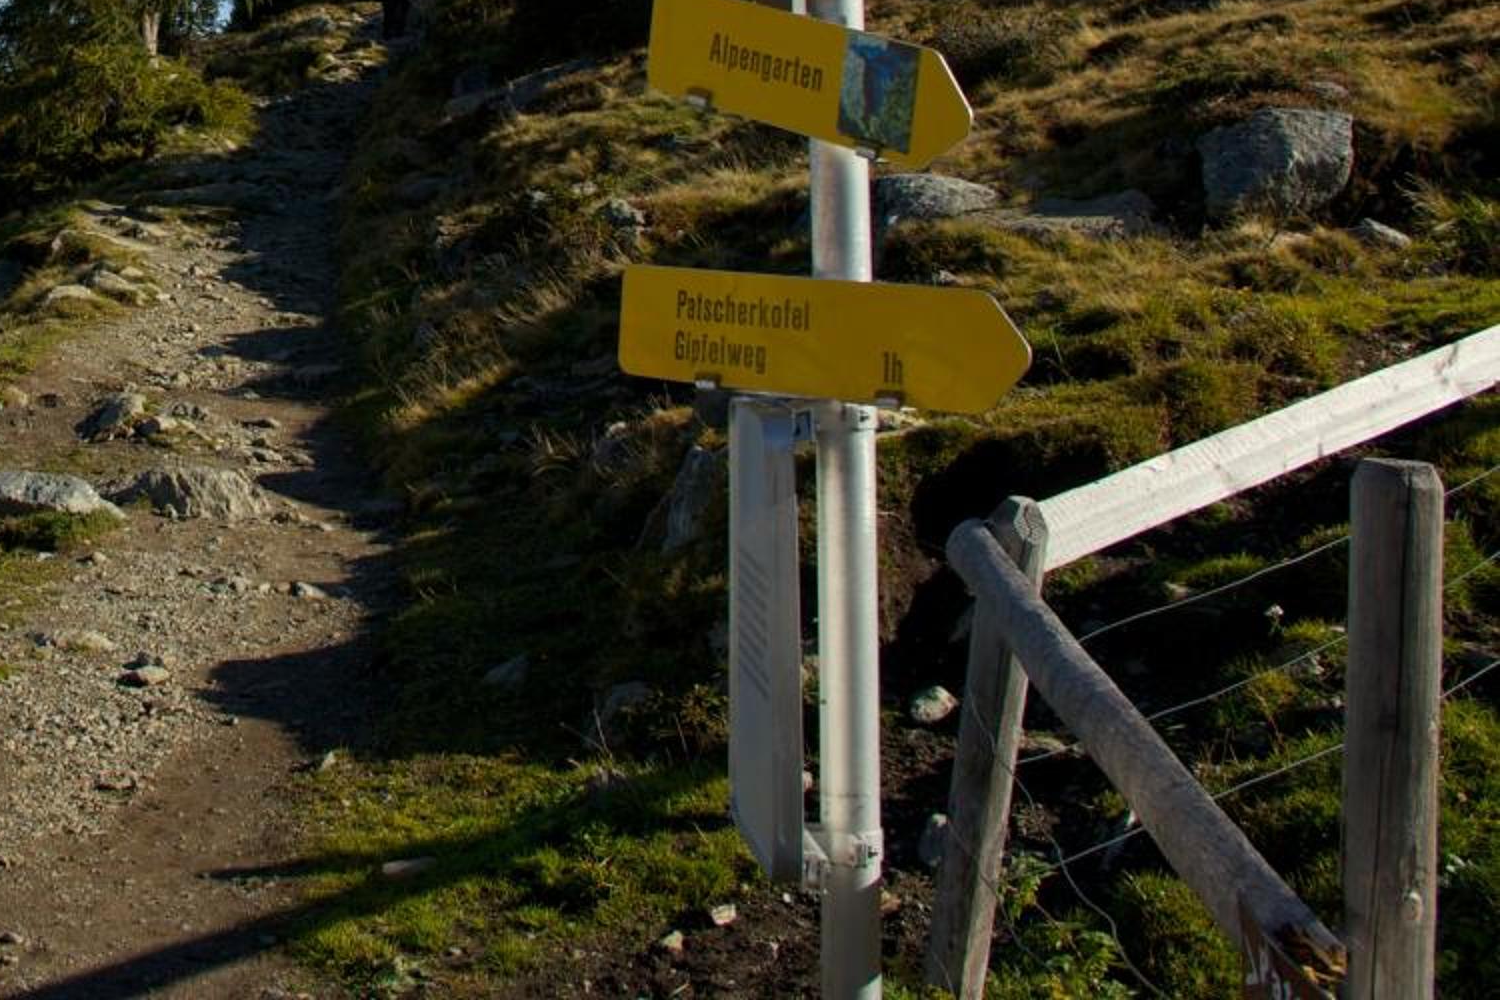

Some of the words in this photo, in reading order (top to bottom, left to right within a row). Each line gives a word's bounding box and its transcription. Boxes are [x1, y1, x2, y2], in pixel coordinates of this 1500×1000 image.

[709, 32, 824, 92] Alpengarten
[676, 290, 810, 332] Patscherkofel
[675, 330, 767, 376] Gipfelweg
[882, 351, 904, 385] 1h
